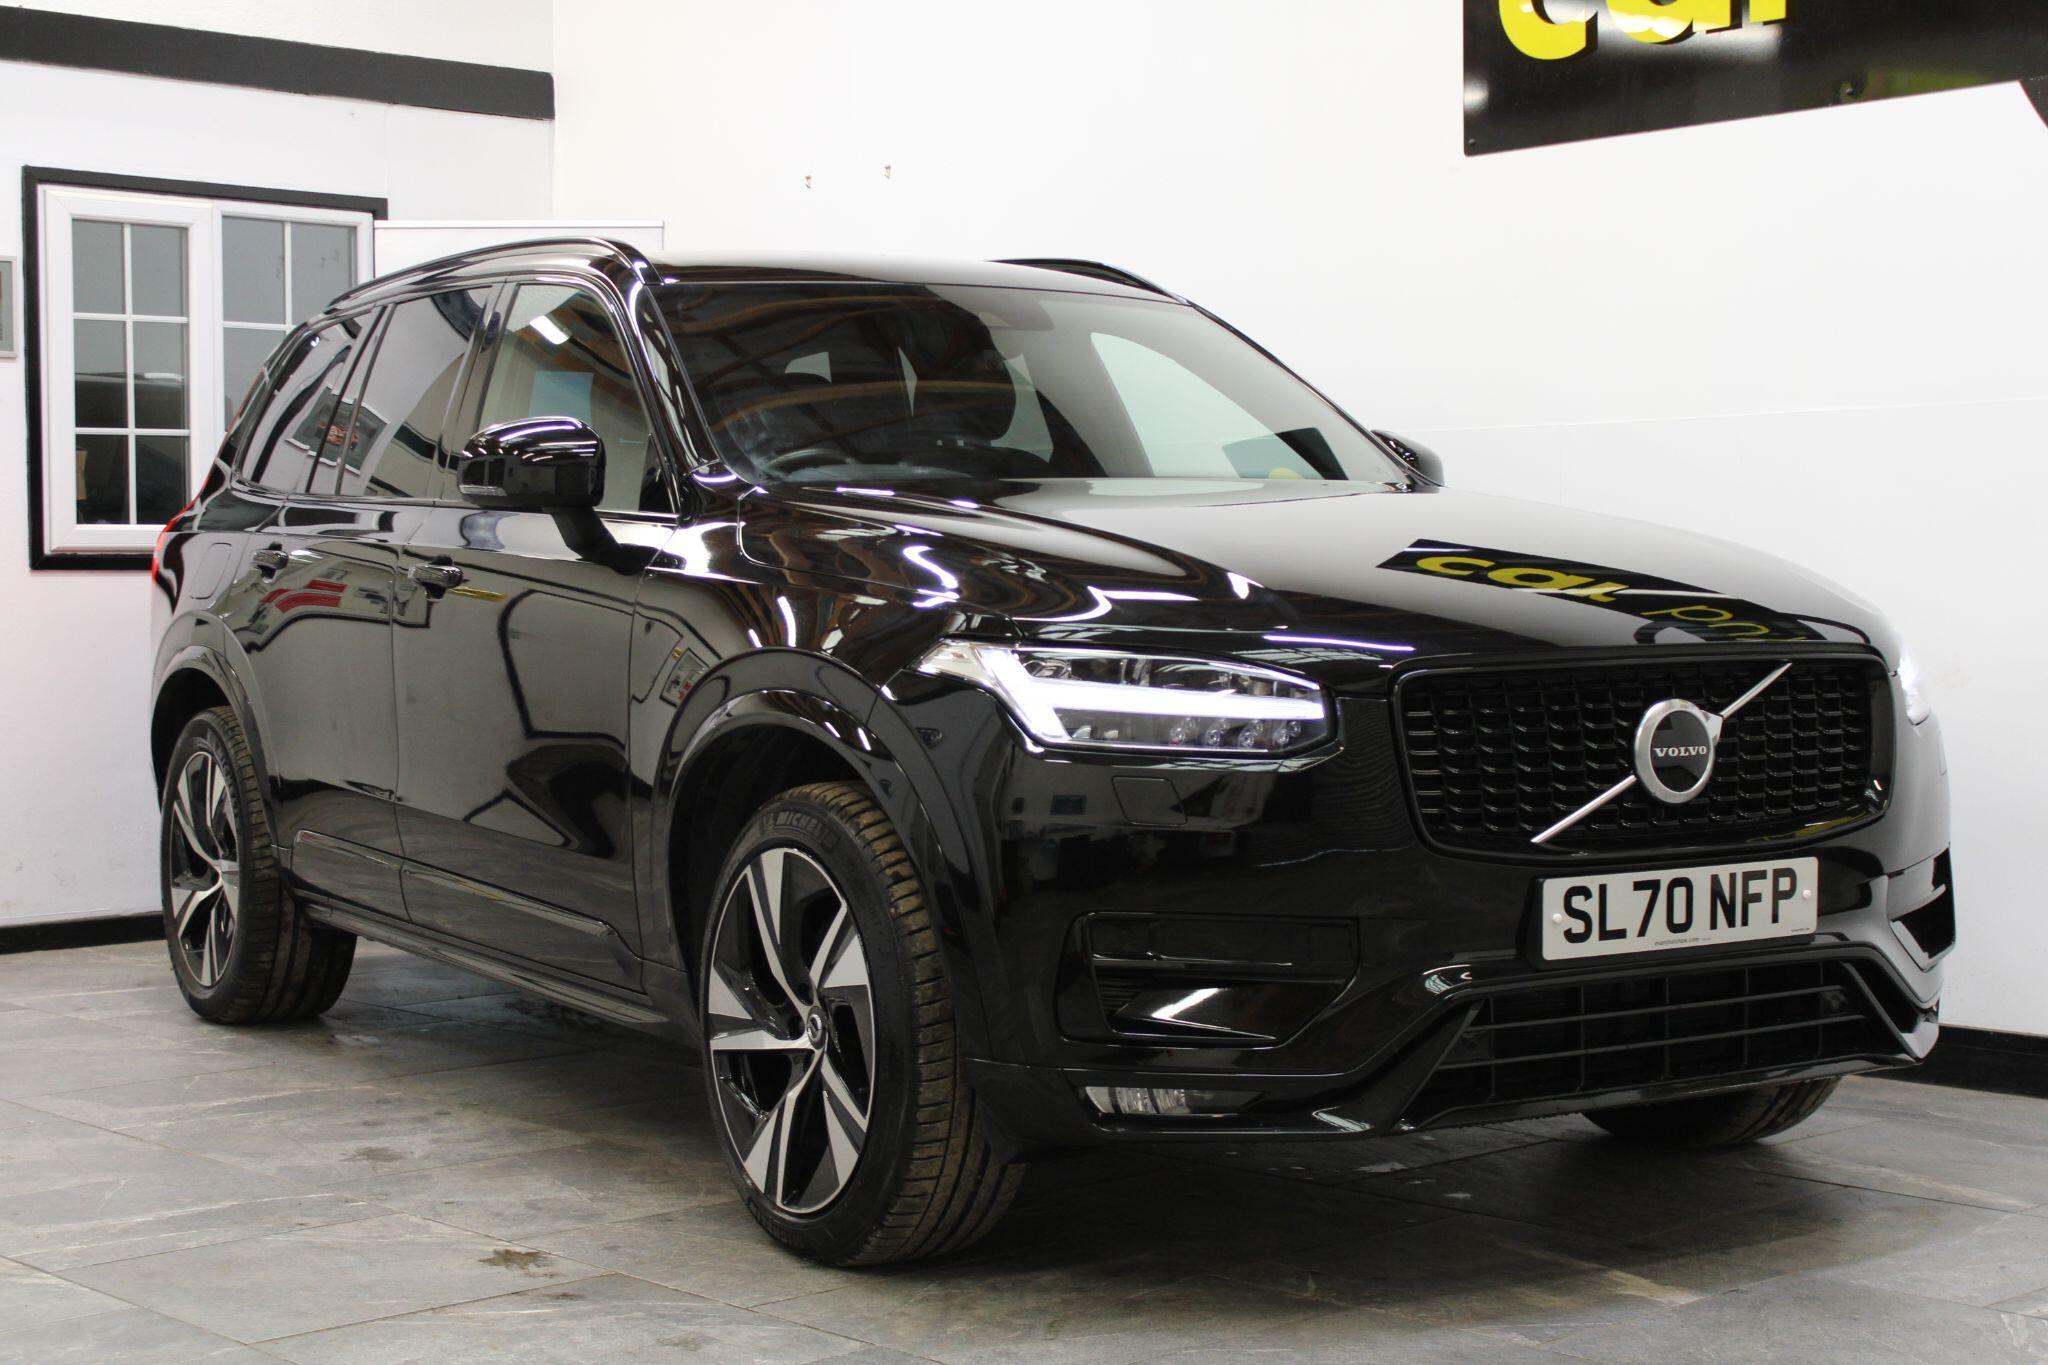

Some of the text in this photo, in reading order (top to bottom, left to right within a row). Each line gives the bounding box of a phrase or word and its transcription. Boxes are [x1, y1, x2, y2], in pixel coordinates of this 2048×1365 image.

[1653, 745, 1707, 758] VOLVO
[1563, 867, 1797, 944] SL70 NFP
